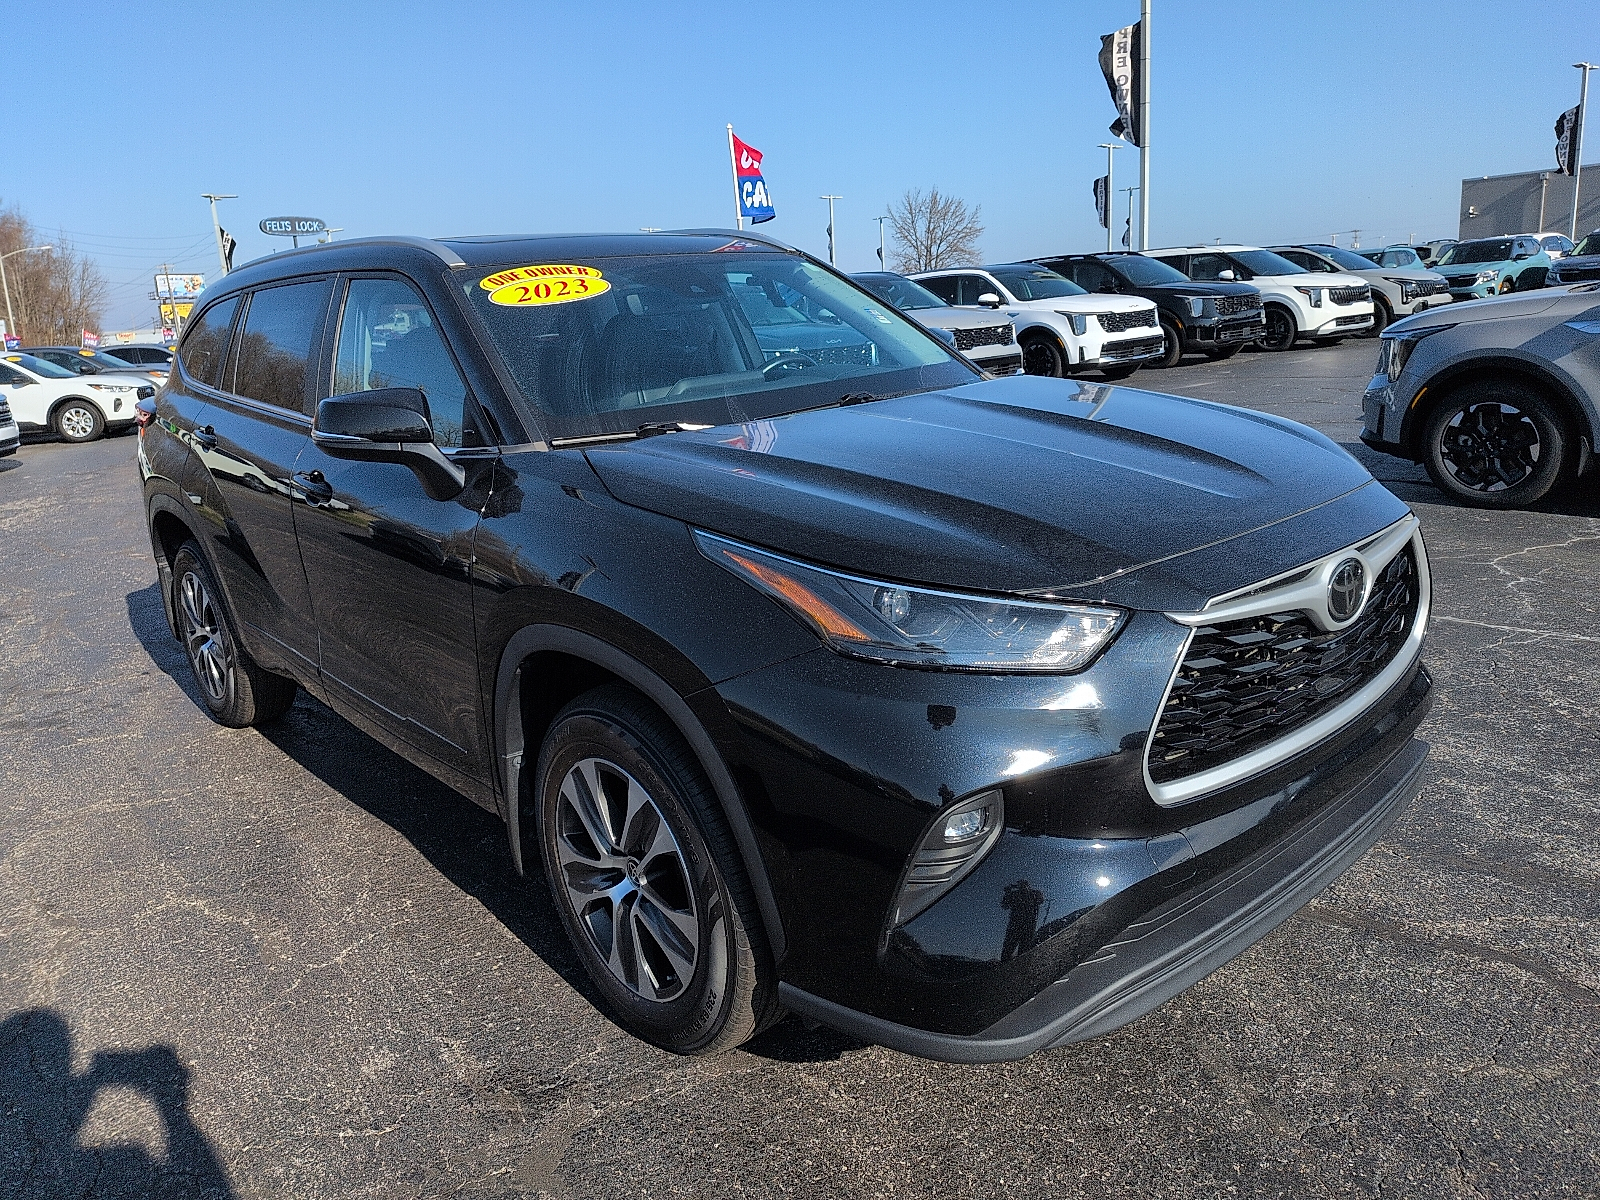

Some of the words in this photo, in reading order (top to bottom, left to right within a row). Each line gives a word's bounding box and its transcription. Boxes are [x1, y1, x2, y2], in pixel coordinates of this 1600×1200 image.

[266, 220, 292, 231] FELTS
[296, 220, 320, 231] LOCK
[487, 271, 522, 286] ONE
[523, 266, 589, 278] OWNER
[514, 278, 589, 303] 2023
